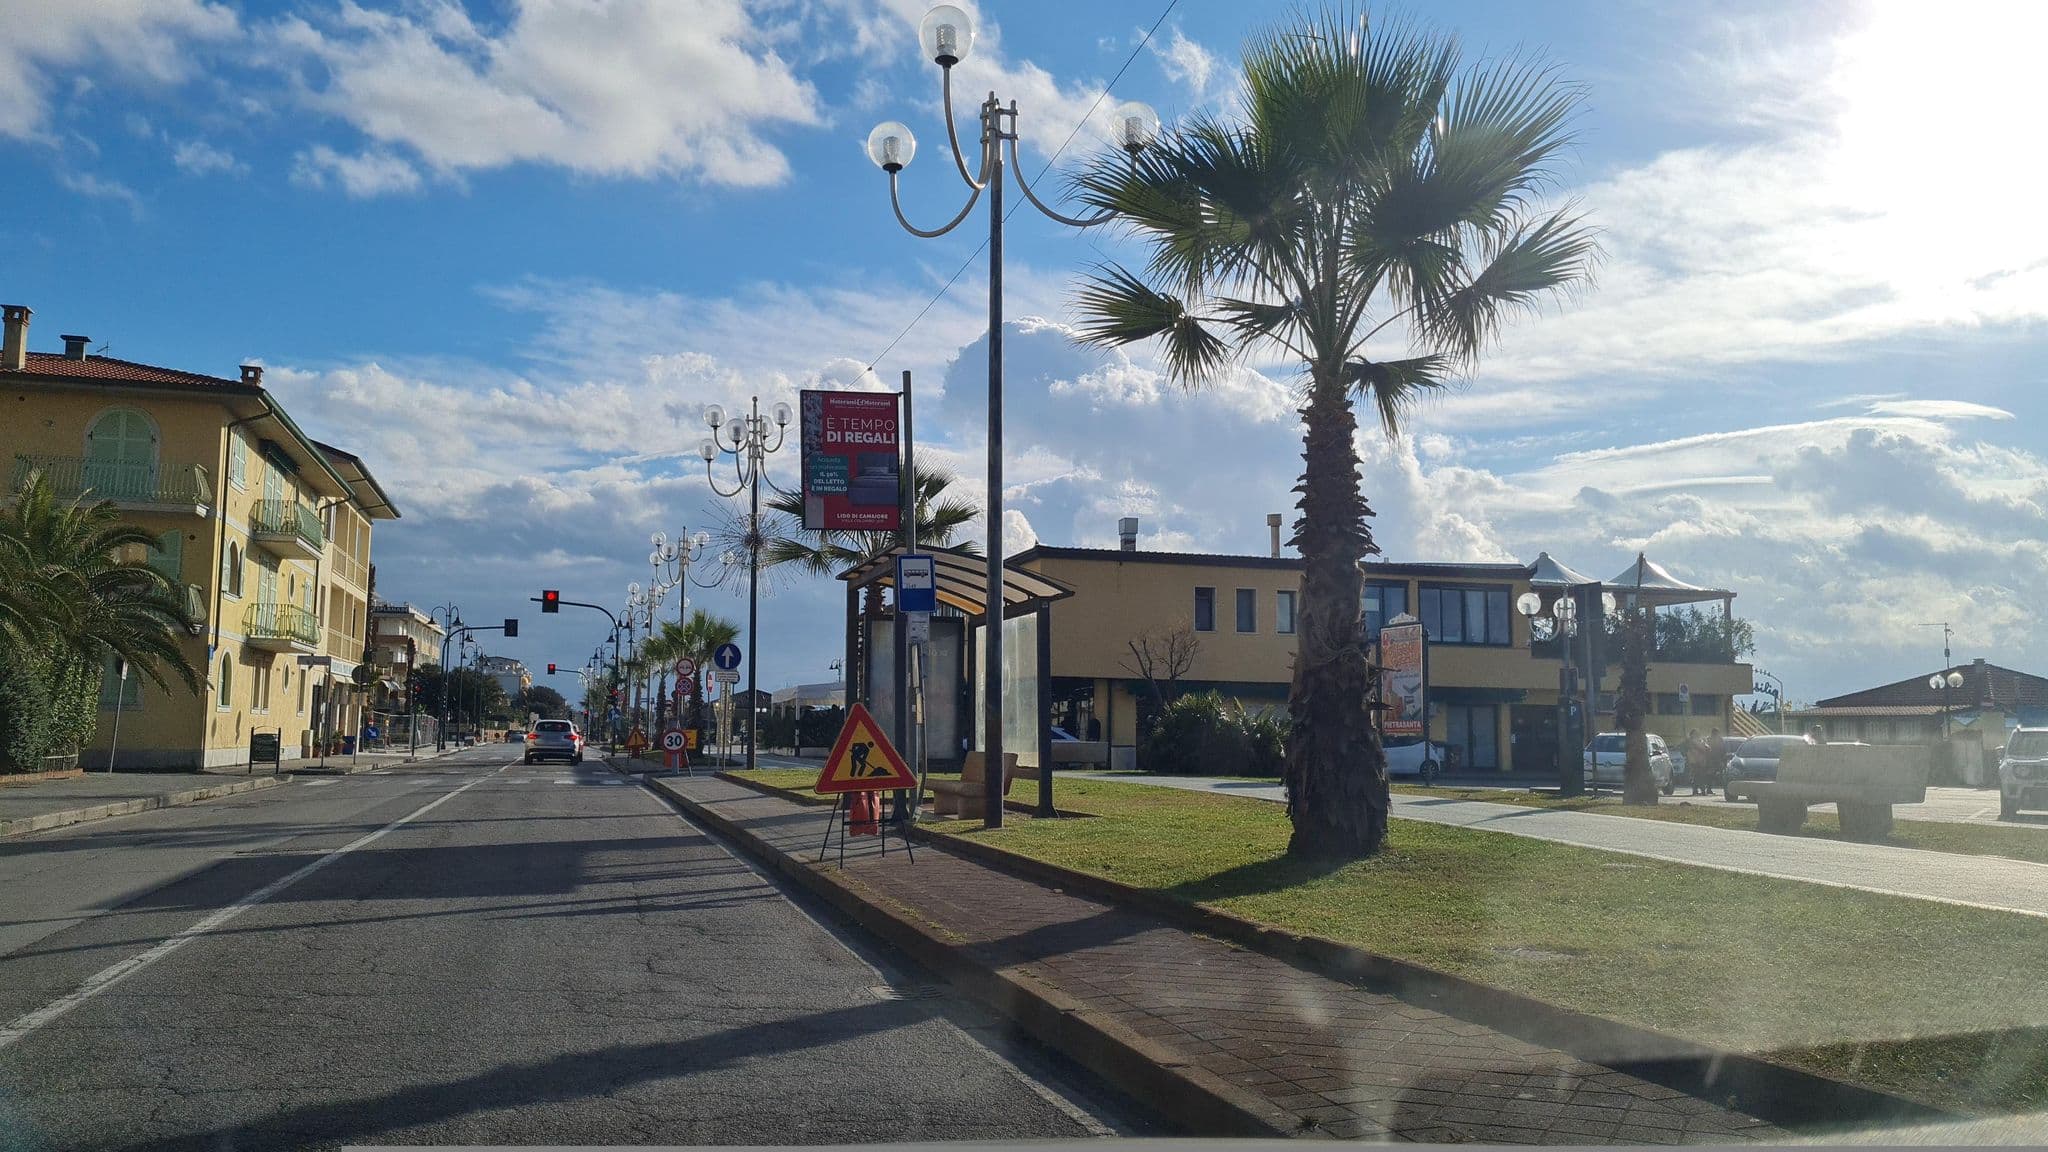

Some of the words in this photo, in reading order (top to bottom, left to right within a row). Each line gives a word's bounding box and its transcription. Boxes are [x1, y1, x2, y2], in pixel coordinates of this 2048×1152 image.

[827, 415, 835, 429] È
[840, 418, 895, 431] TEMPO
[827, 432, 841, 442] DI
[845, 432, 895, 444] REGALI
[1570, 705, 1577, 716] P
[666, 735, 682, 747] 30
